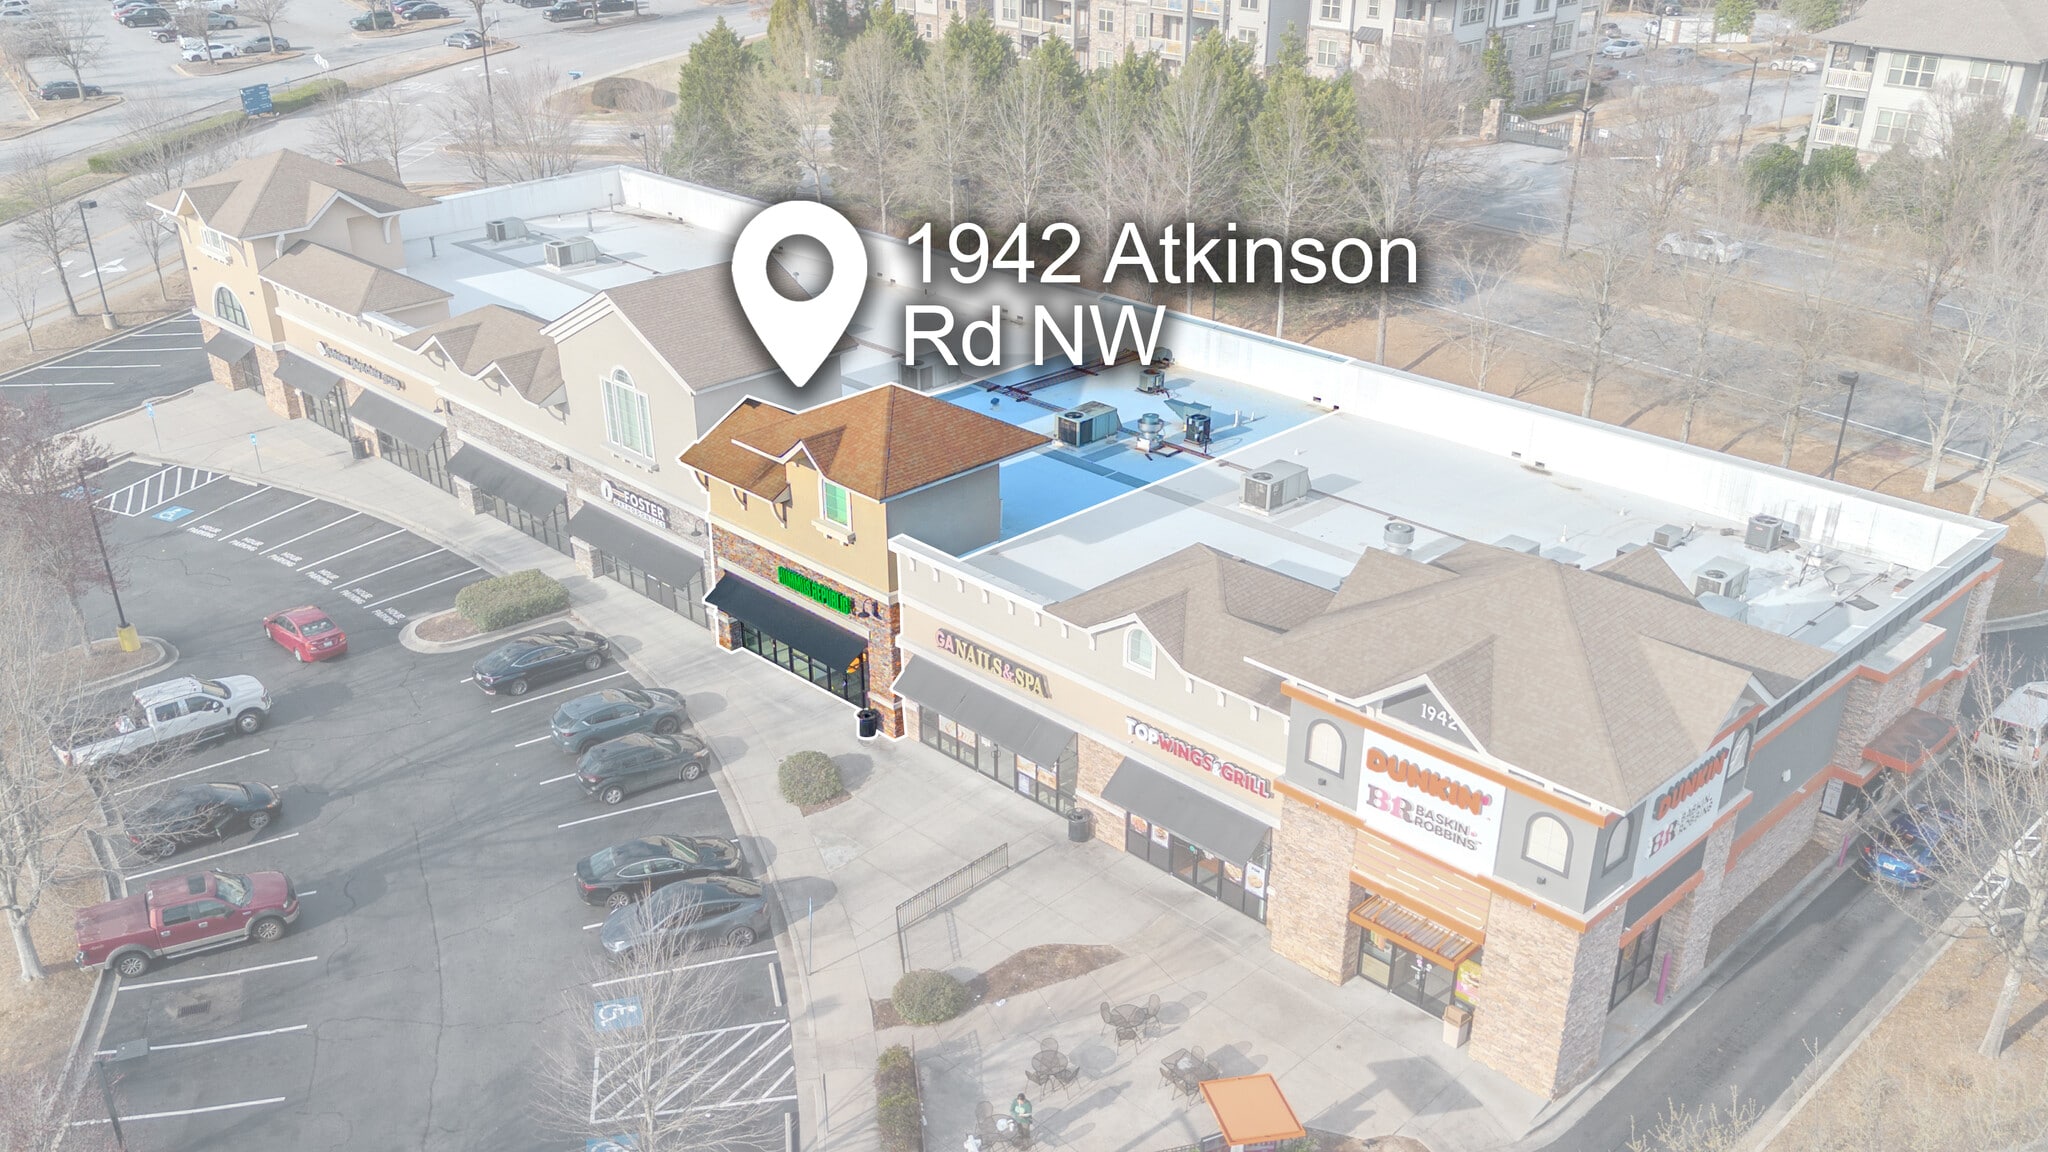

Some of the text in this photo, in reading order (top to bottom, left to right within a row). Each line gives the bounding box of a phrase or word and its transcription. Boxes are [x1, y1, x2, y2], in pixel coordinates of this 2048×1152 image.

[624, 490, 665, 521] FOSTER
[1421, 703, 1458, 731] 1942
[1158, 733, 1215, 772] WINGS
[1221, 763, 1270, 799] GRILL
[1366, 783, 1413, 824] BR
[1415, 804, 1470, 836] BASKIN
[1414, 815, 1477, 851] ROBBINS
